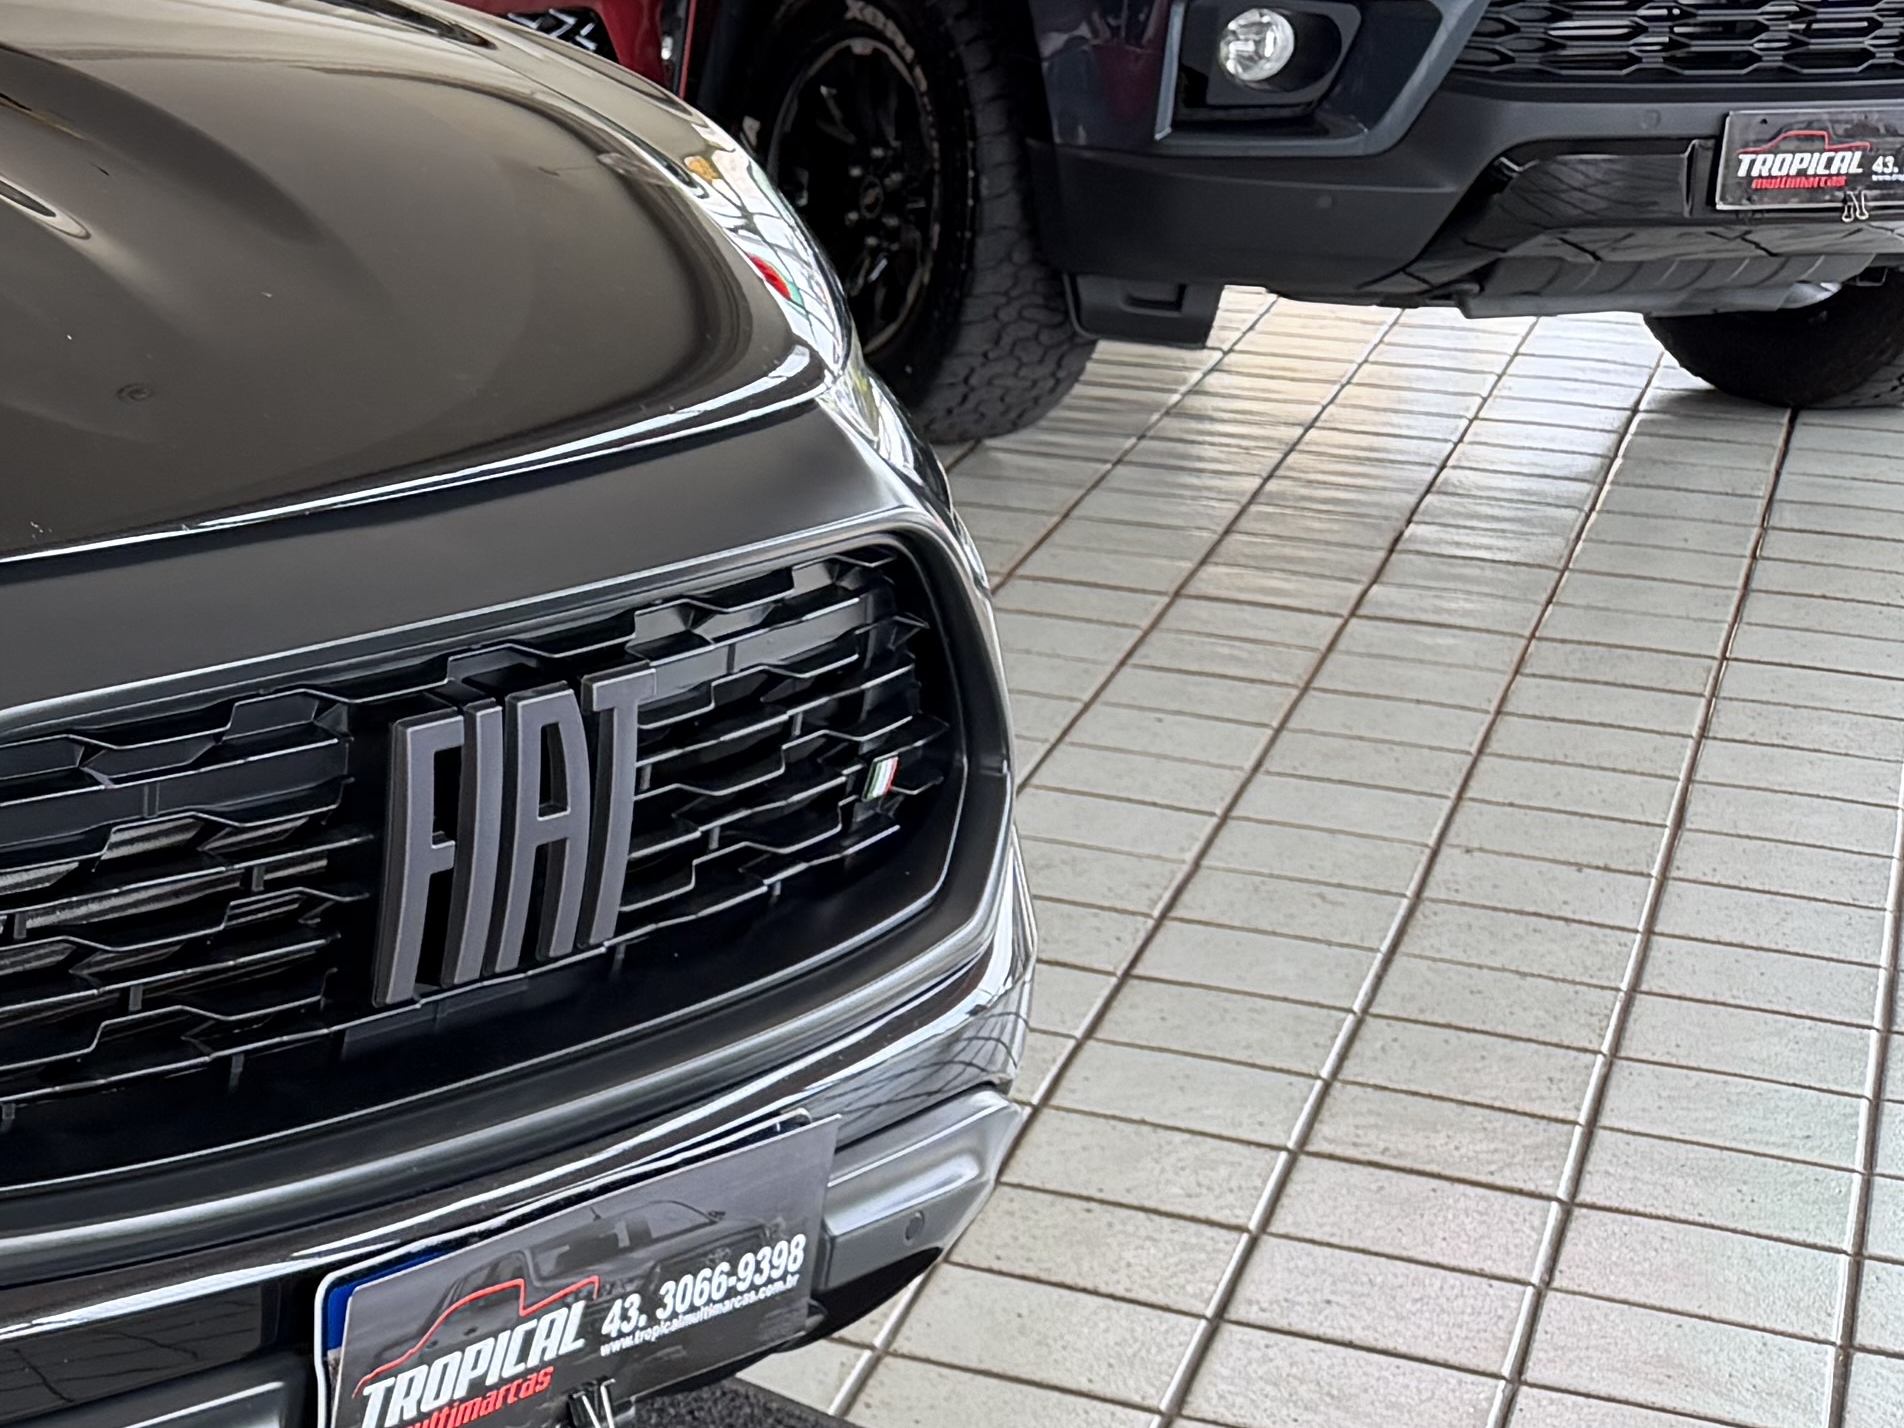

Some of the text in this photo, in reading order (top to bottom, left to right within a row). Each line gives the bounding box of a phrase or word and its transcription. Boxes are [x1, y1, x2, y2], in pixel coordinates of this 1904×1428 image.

[1737, 151, 1863, 177] TROPICAL
[378, 664, 656, 1006] FIAT
[600, 1274, 801, 1358] www.tropicalmultimarcas.com.br
[655, 1233, 807, 1320] 3066-9398
